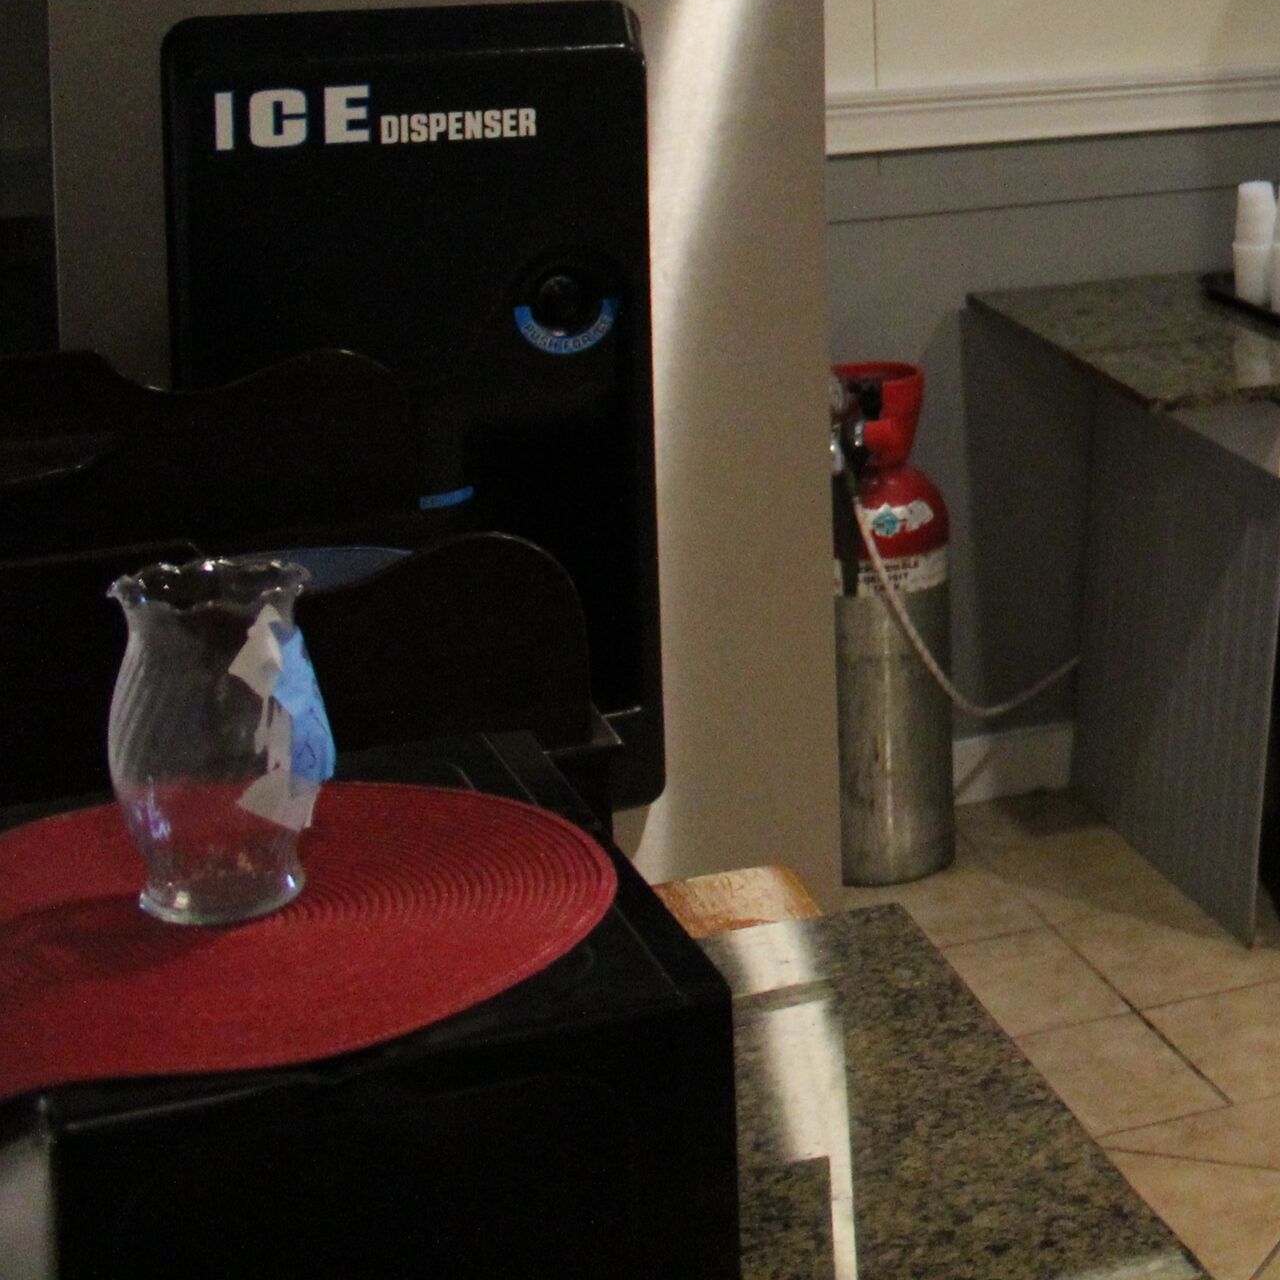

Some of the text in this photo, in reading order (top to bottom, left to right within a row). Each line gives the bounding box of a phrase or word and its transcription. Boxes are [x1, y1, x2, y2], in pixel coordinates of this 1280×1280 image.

[214, 83, 537, 151] ICE DISPENSER
[523, 323, 560, 352] PUSH
[563, 334, 592, 351] FOR
